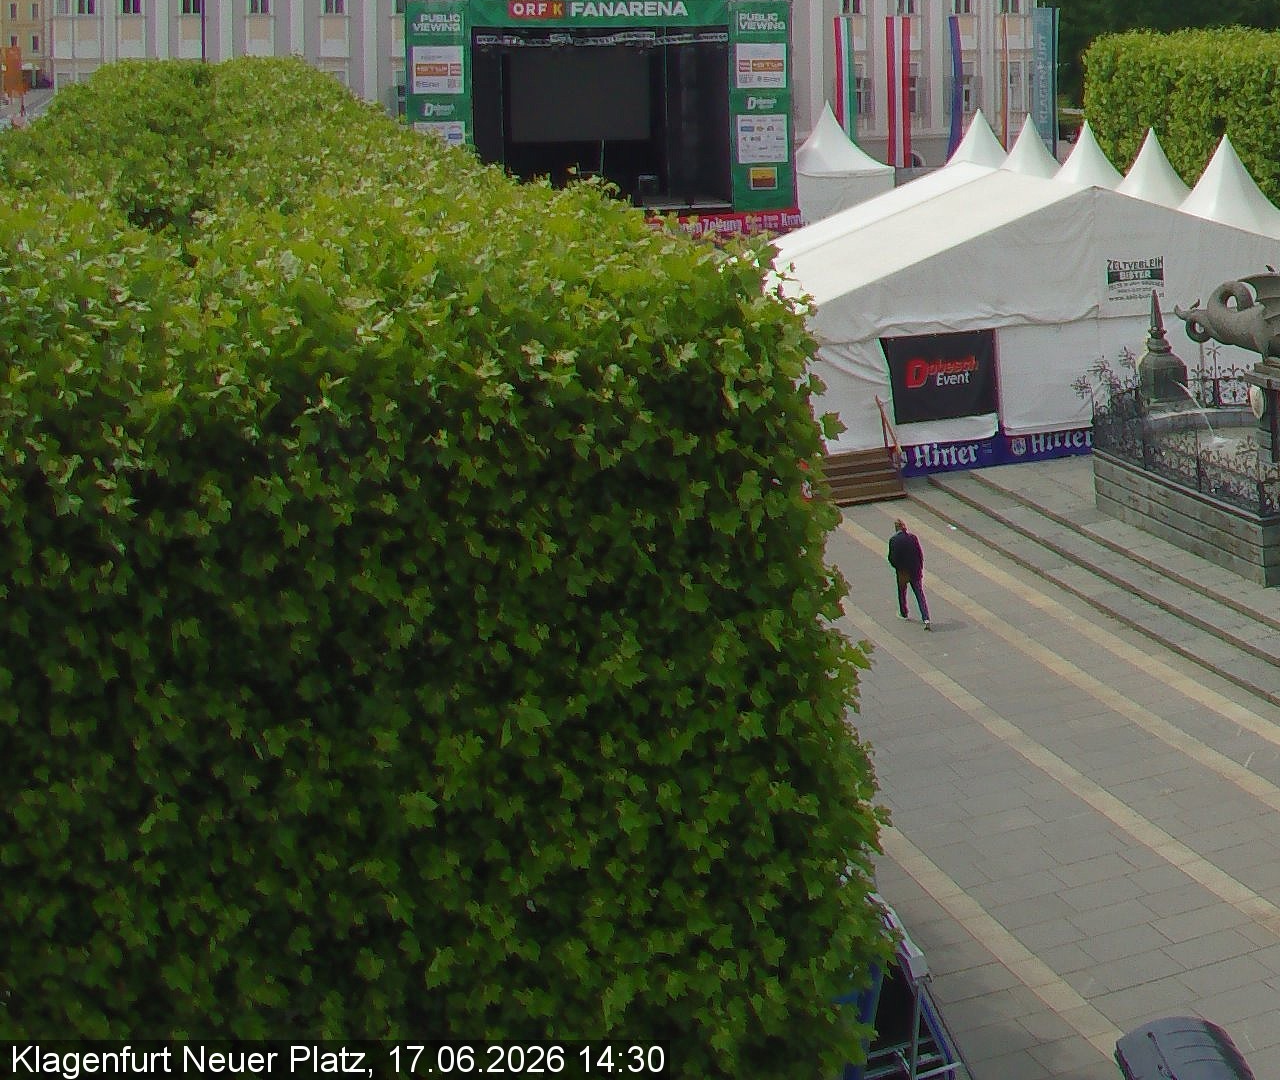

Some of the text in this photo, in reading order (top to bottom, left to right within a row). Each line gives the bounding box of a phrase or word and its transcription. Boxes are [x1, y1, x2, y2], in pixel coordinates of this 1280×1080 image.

[513, 1, 688, 17] ORF K FANARENA
[420, 13, 460, 23] PUBLIC
[739, 13, 778, 21] PUBLIC
[413, 22, 460, 32] VIEWING
[739, 21, 785, 30] VIEWING
[936, 371, 970, 387] Event
[914, 443, 979, 468] Hirter
